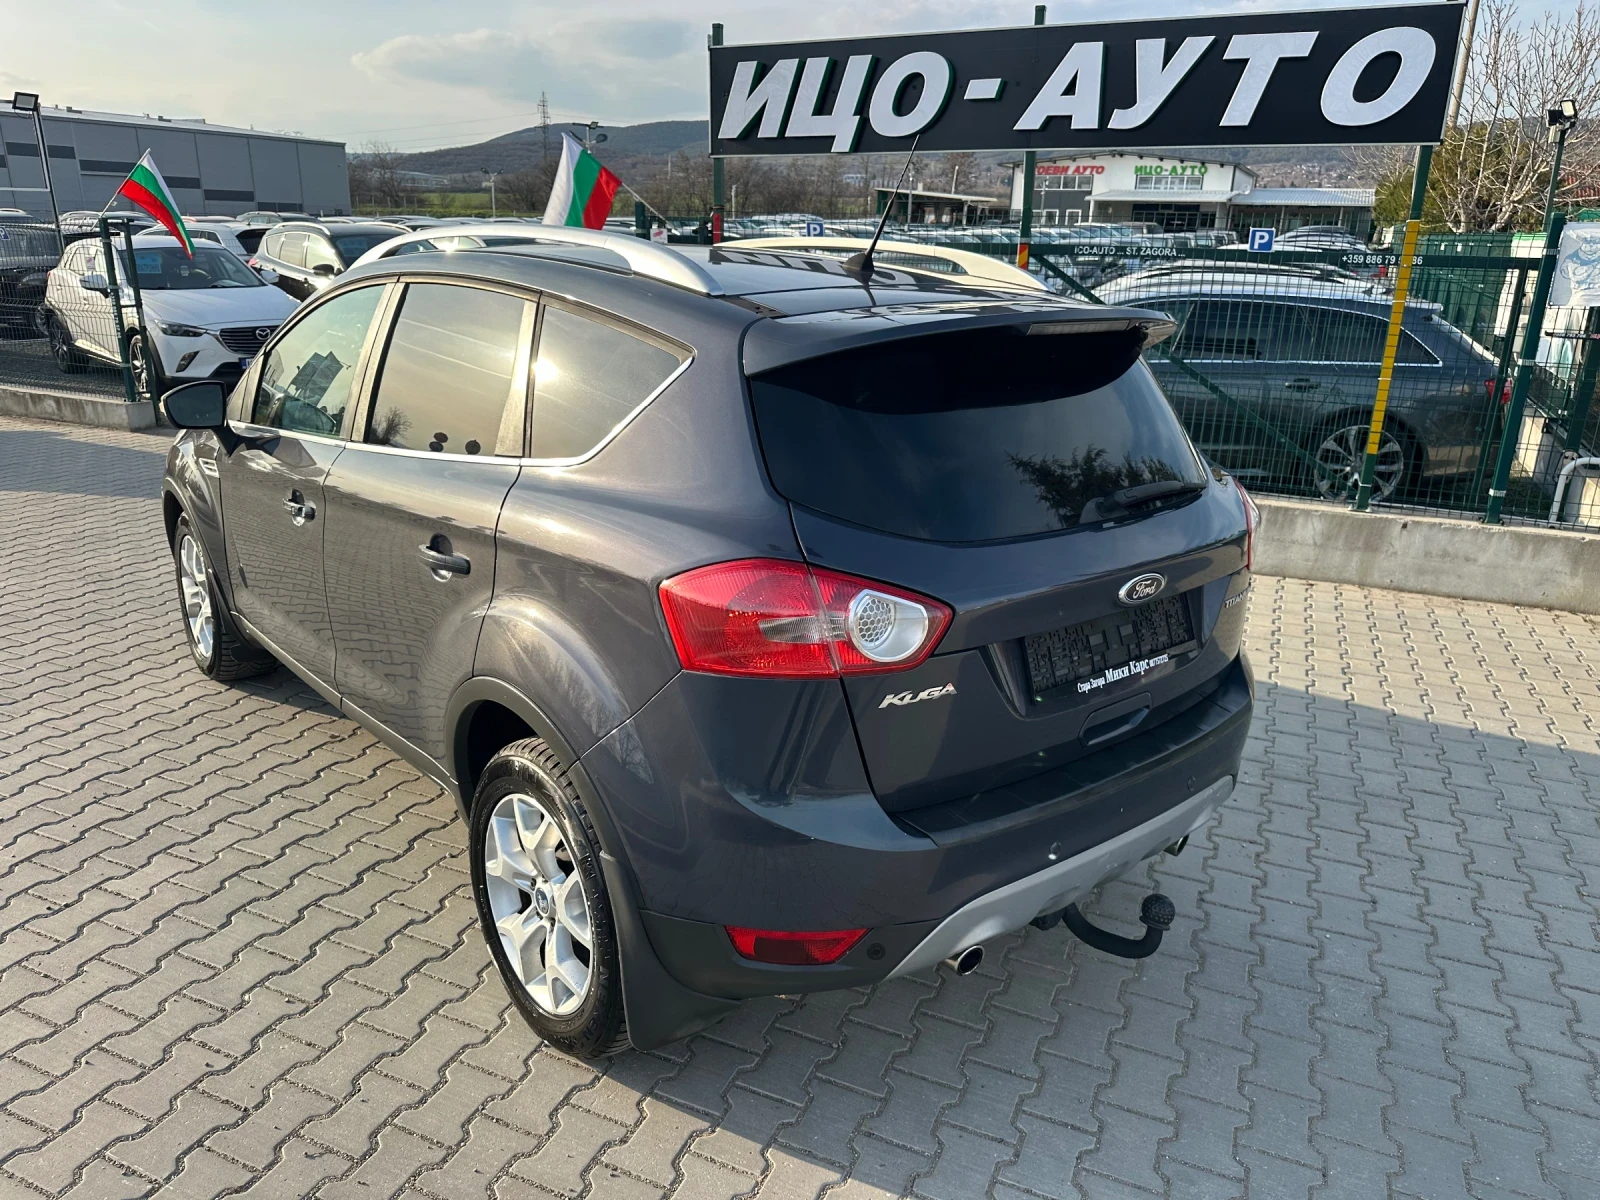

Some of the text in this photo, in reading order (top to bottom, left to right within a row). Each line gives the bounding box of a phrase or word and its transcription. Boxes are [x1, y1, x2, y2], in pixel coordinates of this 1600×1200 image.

[1036, 165, 1105, 175] ОЕВИ АУТО
[1134, 164, 1208, 175] ИЦО-АУТО
[809, 224, 820, 236] P
[1253, 232, 1269, 249] P
[1074, 246, 1115, 255] ICO-AUTO
[1126, 247, 1138, 256] ST.
[1140, 247, 1177, 257] ZAGORA
[1342, 255, 1364, 264] +359
[1366, 255, 1382, 264] 886
[1384, 255, 1396, 264] 79
[1133, 580, 1157, 599] Ford
[1077, 682, 1091, 693] Стара
[1090, 677, 1106, 688] Загора
[1105, 666, 1130, 683] Мики
[1129, 659, 1149, 675] Карс
[878, 683, 957, 709] KUGA
